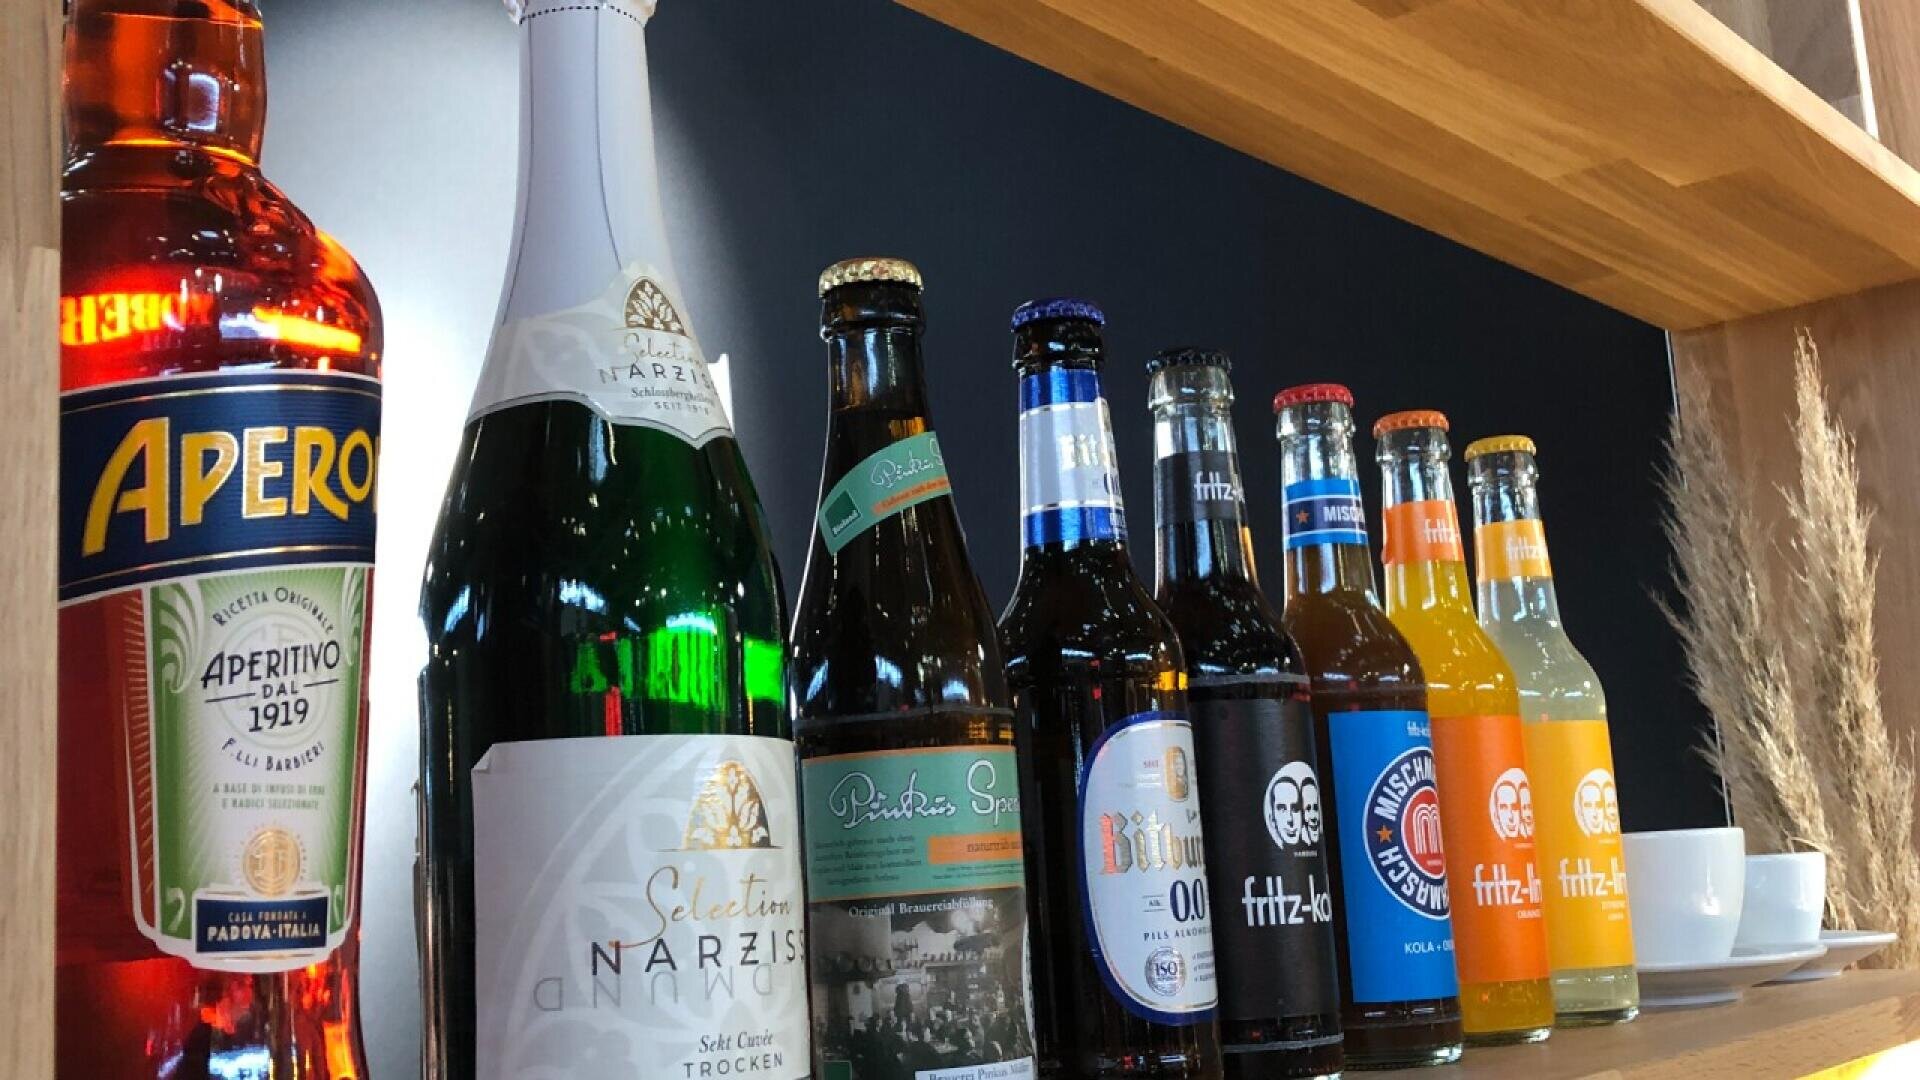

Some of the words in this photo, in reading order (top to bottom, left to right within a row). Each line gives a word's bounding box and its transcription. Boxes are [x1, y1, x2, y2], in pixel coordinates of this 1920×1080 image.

[81, 416, 378, 557] APERO
[212, 591, 269, 627] RICETTA
[274, 586, 334, 636] ORIGINALE
[200, 639, 341, 690] APERITIVO
[262, 680, 299, 699] DAL
[248, 698, 309, 733] 1919
[266, 741, 325, 772] BARBIERI
[228, 911, 253, 923] CASA
[608, 865, 792, 948] Selection
[849, 902, 895, 918] Original
[1143, 929, 1170, 941] PILS
[1403, 940, 1434, 954] KOLA
[699, 1033, 732, 1053] Sekt
[683, 1051, 783, 1079] TROCKEN
